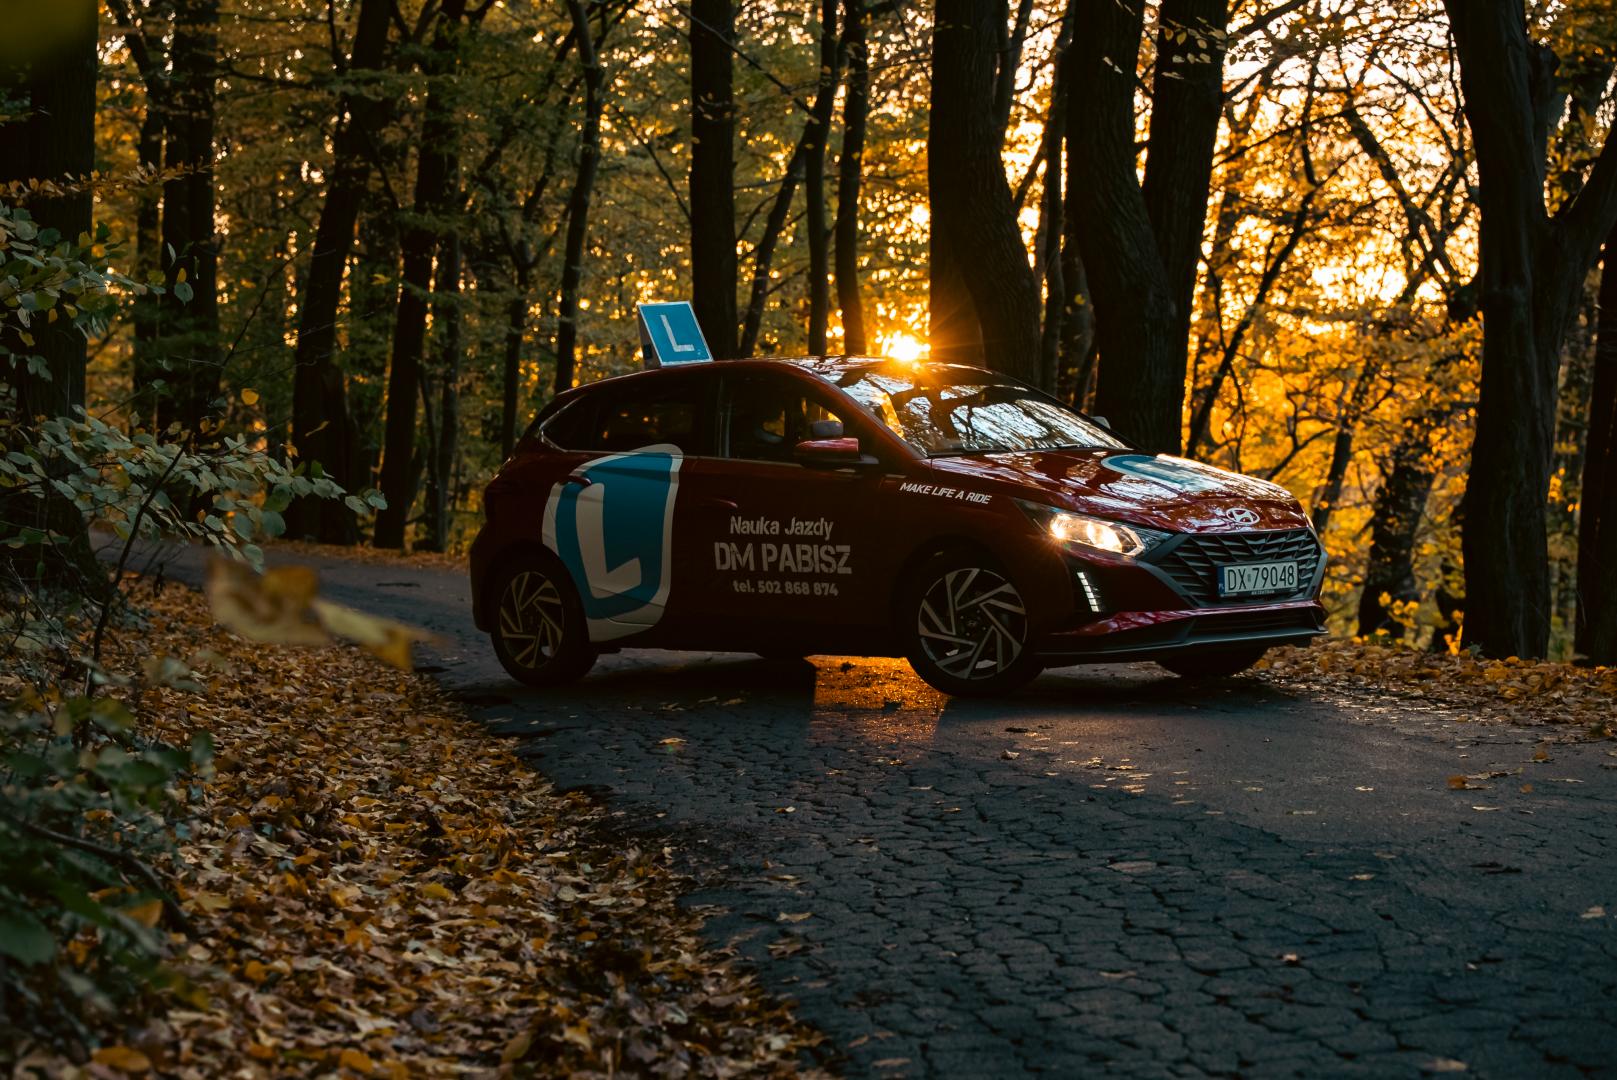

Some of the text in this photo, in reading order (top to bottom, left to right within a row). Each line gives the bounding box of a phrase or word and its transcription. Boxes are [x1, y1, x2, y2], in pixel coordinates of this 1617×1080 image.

[661, 314, 695, 352] L
[900, 482, 992, 505] MAKE LIFE A RIDE
[730, 516, 834, 541] Nauka Jazdy
[714, 542, 852, 574] DM PABISZ
[732, 580, 839, 596] tel. 502 868 874
[1227, 565, 1294, 591] DX 79048
